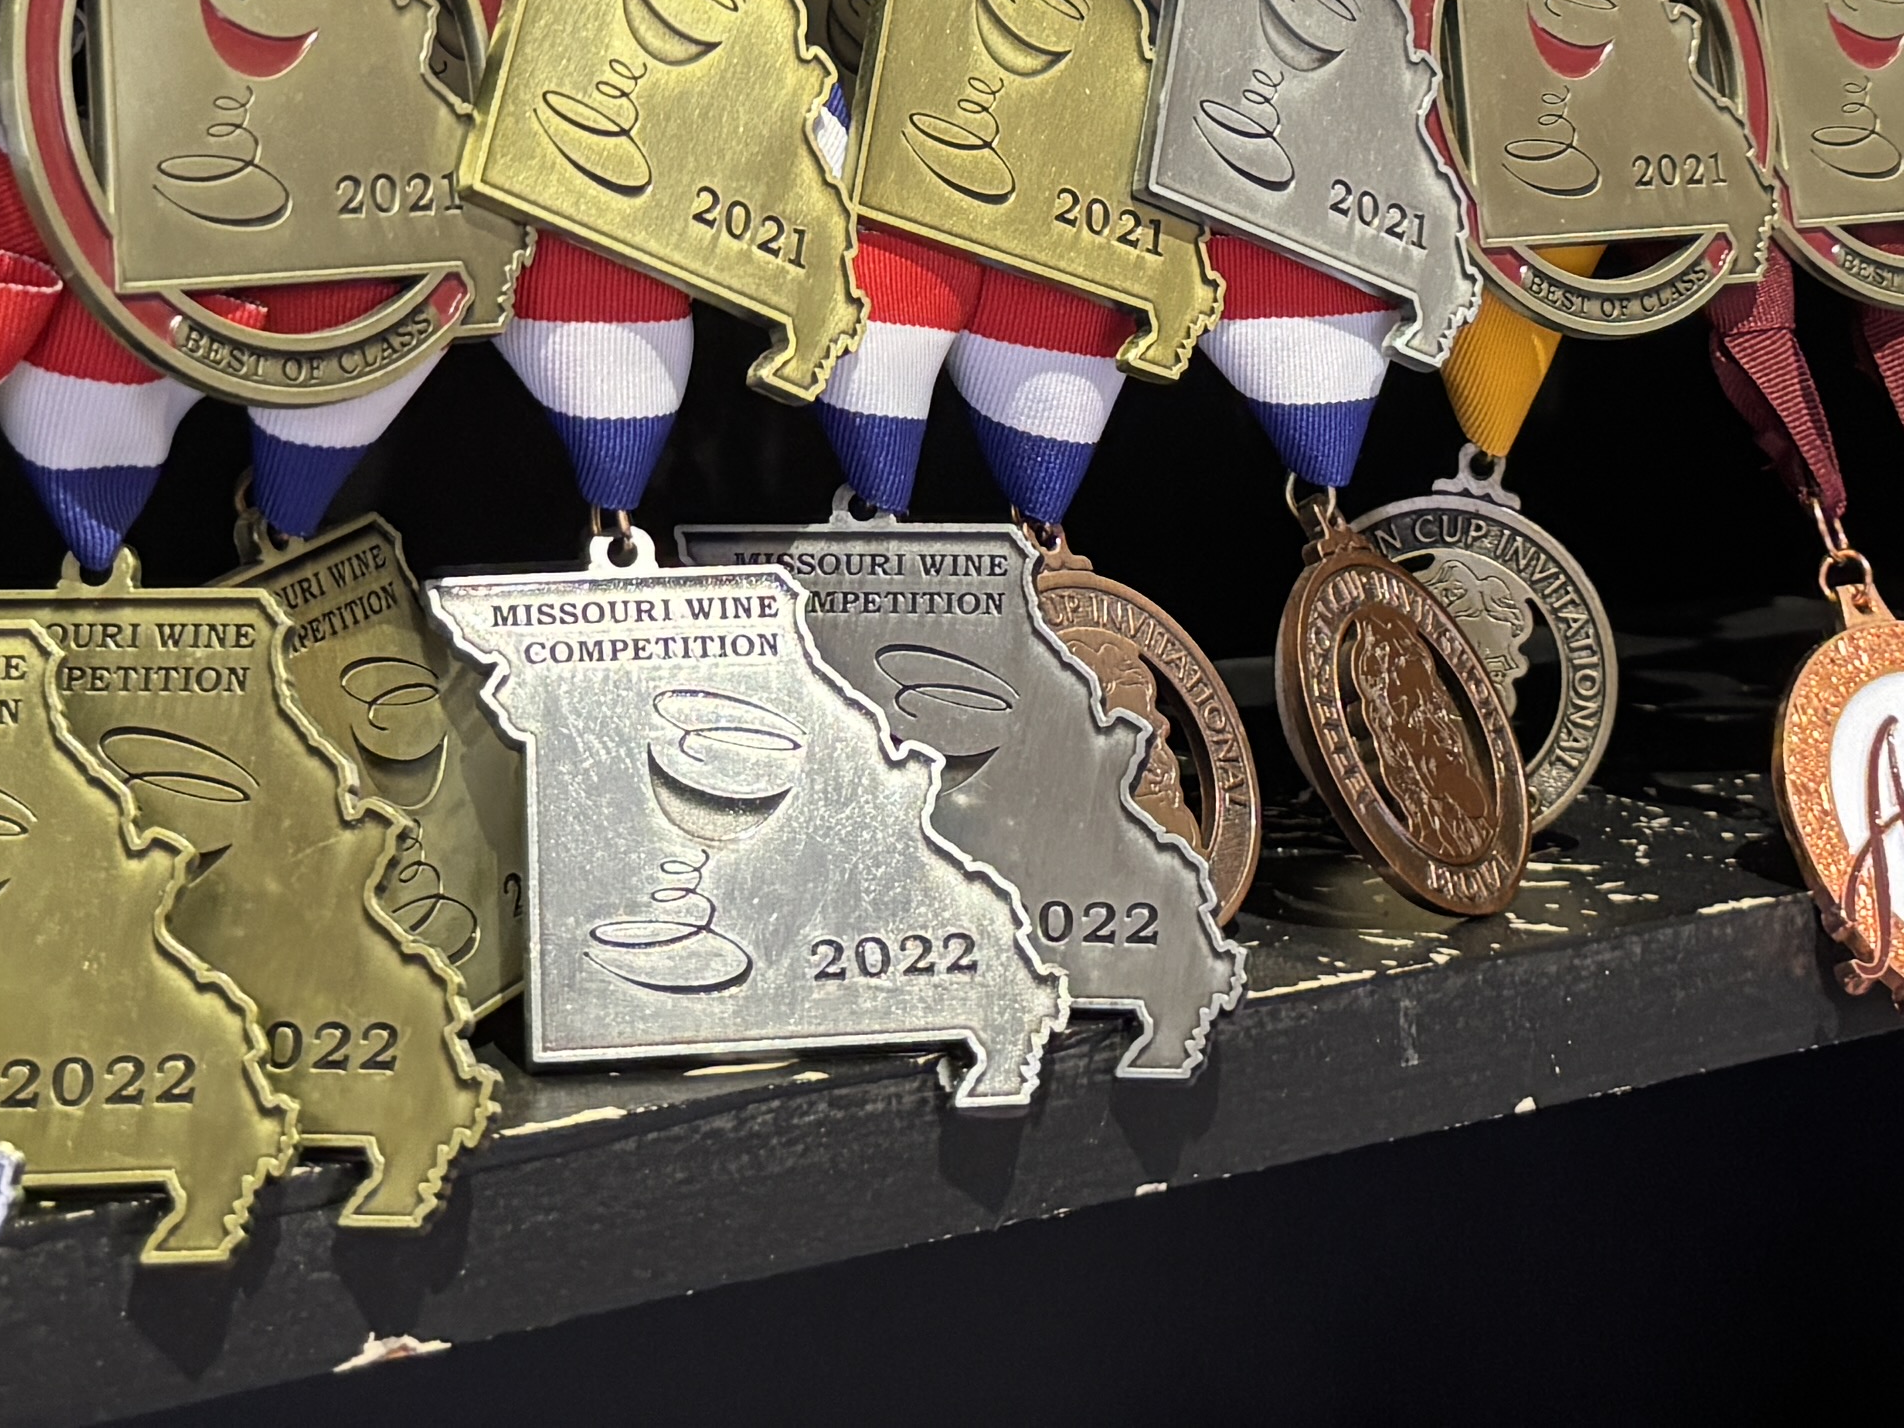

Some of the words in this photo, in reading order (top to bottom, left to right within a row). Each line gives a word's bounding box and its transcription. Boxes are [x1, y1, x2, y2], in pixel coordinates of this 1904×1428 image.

[336, 172, 464, 217] 2021
[1632, 155, 1727, 189] 2021
[692, 185, 808, 270] 2021
[1328, 180, 1428, 249] 2021
[1526, 274, 1593, 318] BEST
[1600, 294, 1632, 318] OF
[1637, 266, 1708, 312] CLASS
[181, 321, 274, 383] BEST
[283, 355, 325, 383] OF
[336, 311, 434, 373] CLASS
[492, 597, 679, 628] MISSOURI
[685, 592, 780, 624] WINE
[522, 631, 782, 665] COMPETITION
[810, 931, 980, 983] 2022
